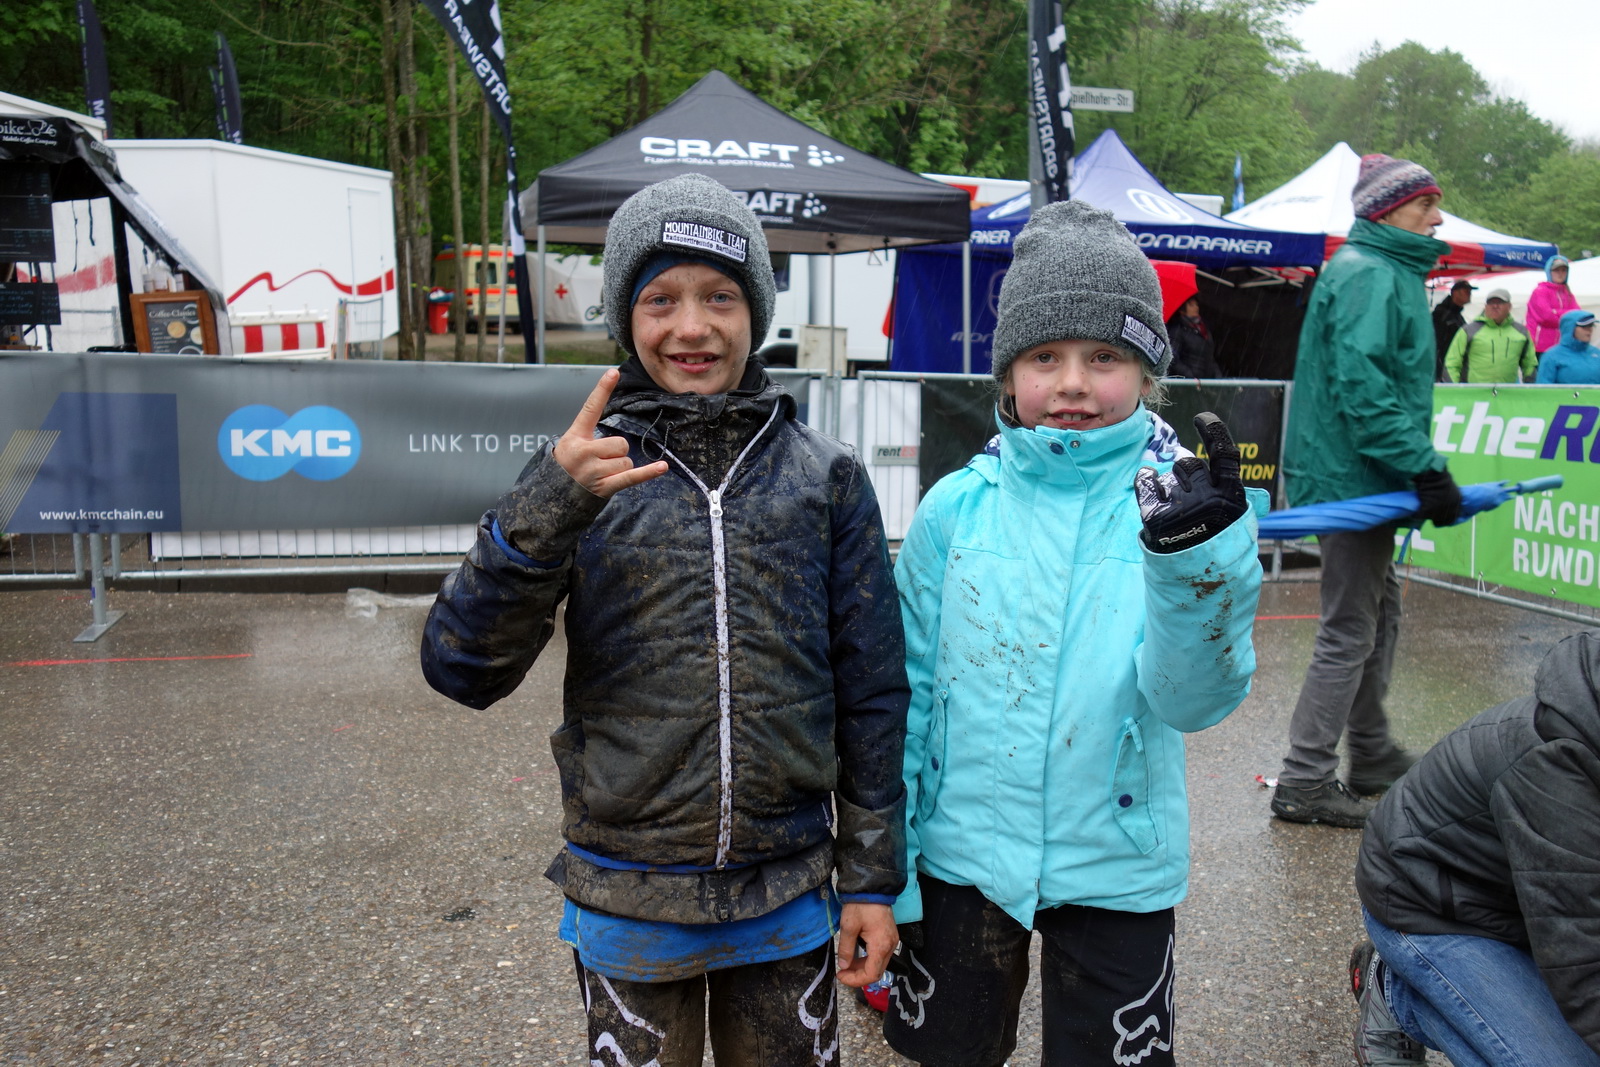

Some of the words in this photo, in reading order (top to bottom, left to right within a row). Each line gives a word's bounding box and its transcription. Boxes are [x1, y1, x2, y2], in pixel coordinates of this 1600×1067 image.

[640, 136, 799, 162] CRAFT
[665, 222, 724, 244] MOUNTAINBIKE
[727, 232, 746, 252] TEAM
[1130, 232, 1273, 255] ONDRAKER
[230, 428, 352, 457] KMC
[409, 433, 463, 453] LINK
[471, 434, 499, 453] TO
[1237, 443, 1259, 460] TO
[39, 507, 164, 521] www.kmcchain.eu
[1512, 537, 1600, 587] RUND
